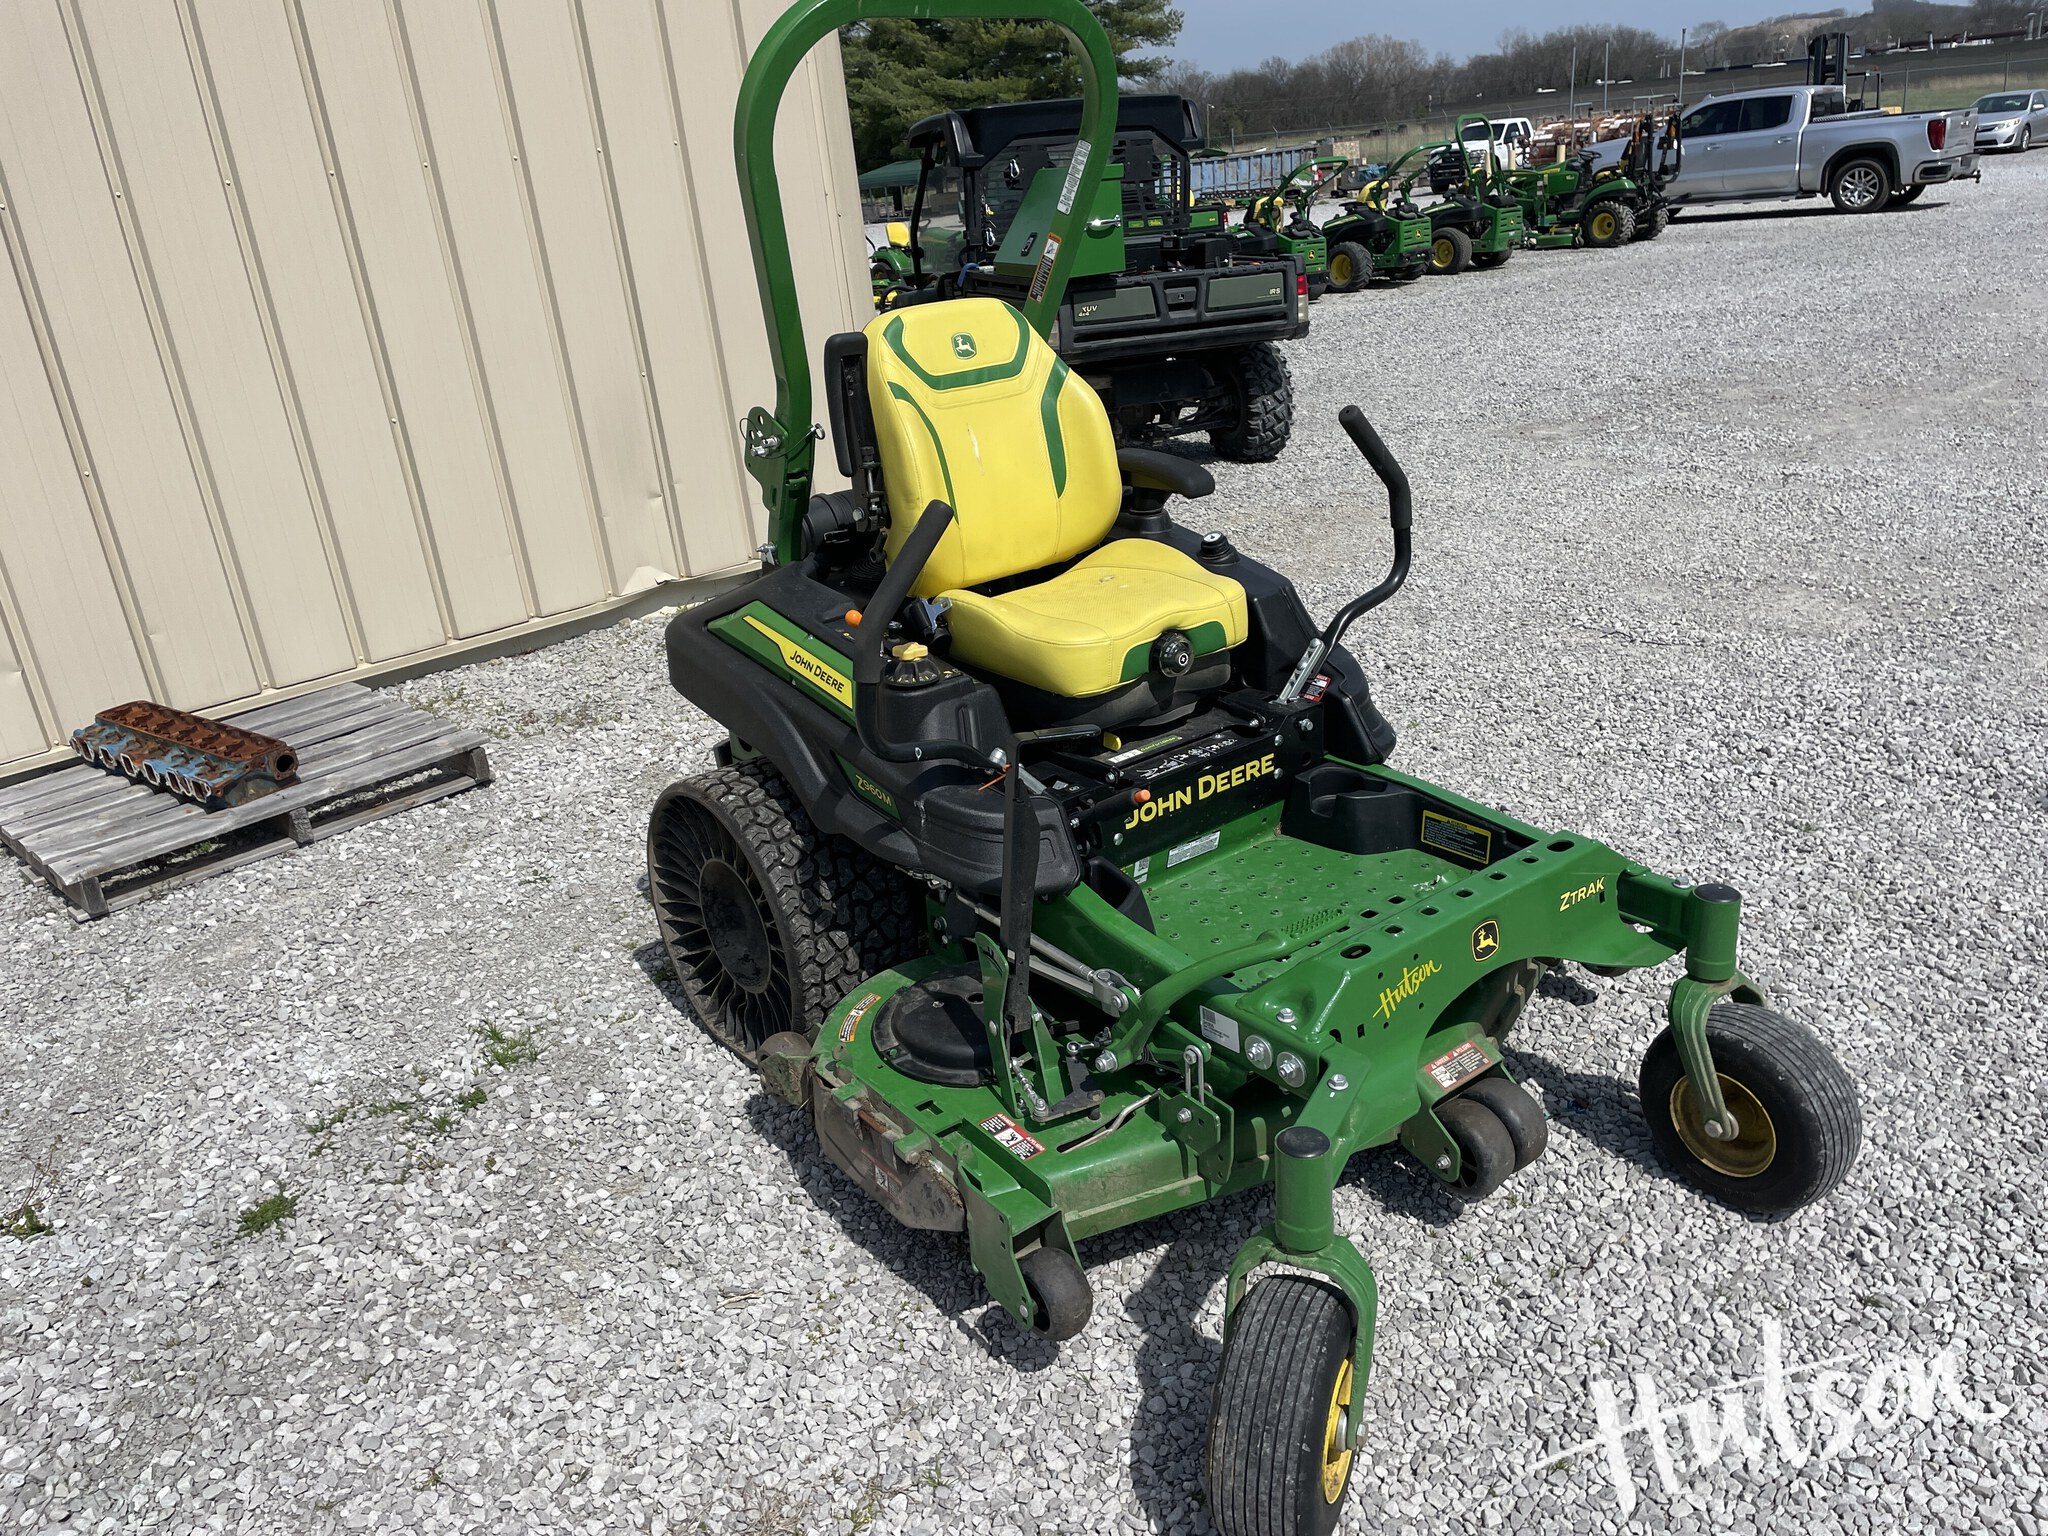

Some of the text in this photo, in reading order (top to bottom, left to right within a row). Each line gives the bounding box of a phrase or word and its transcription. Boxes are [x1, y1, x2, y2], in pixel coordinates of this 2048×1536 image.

[1269, 287, 1280, 295] IRS
[790, 650, 845, 693] JOHN DEERE
[855, 774, 892, 807] Z960M
[1125, 753, 1275, 830] JOHN DEERE
[1559, 876, 1605, 912] ZTRAK
[1372, 959, 1443, 1019] Hutson
